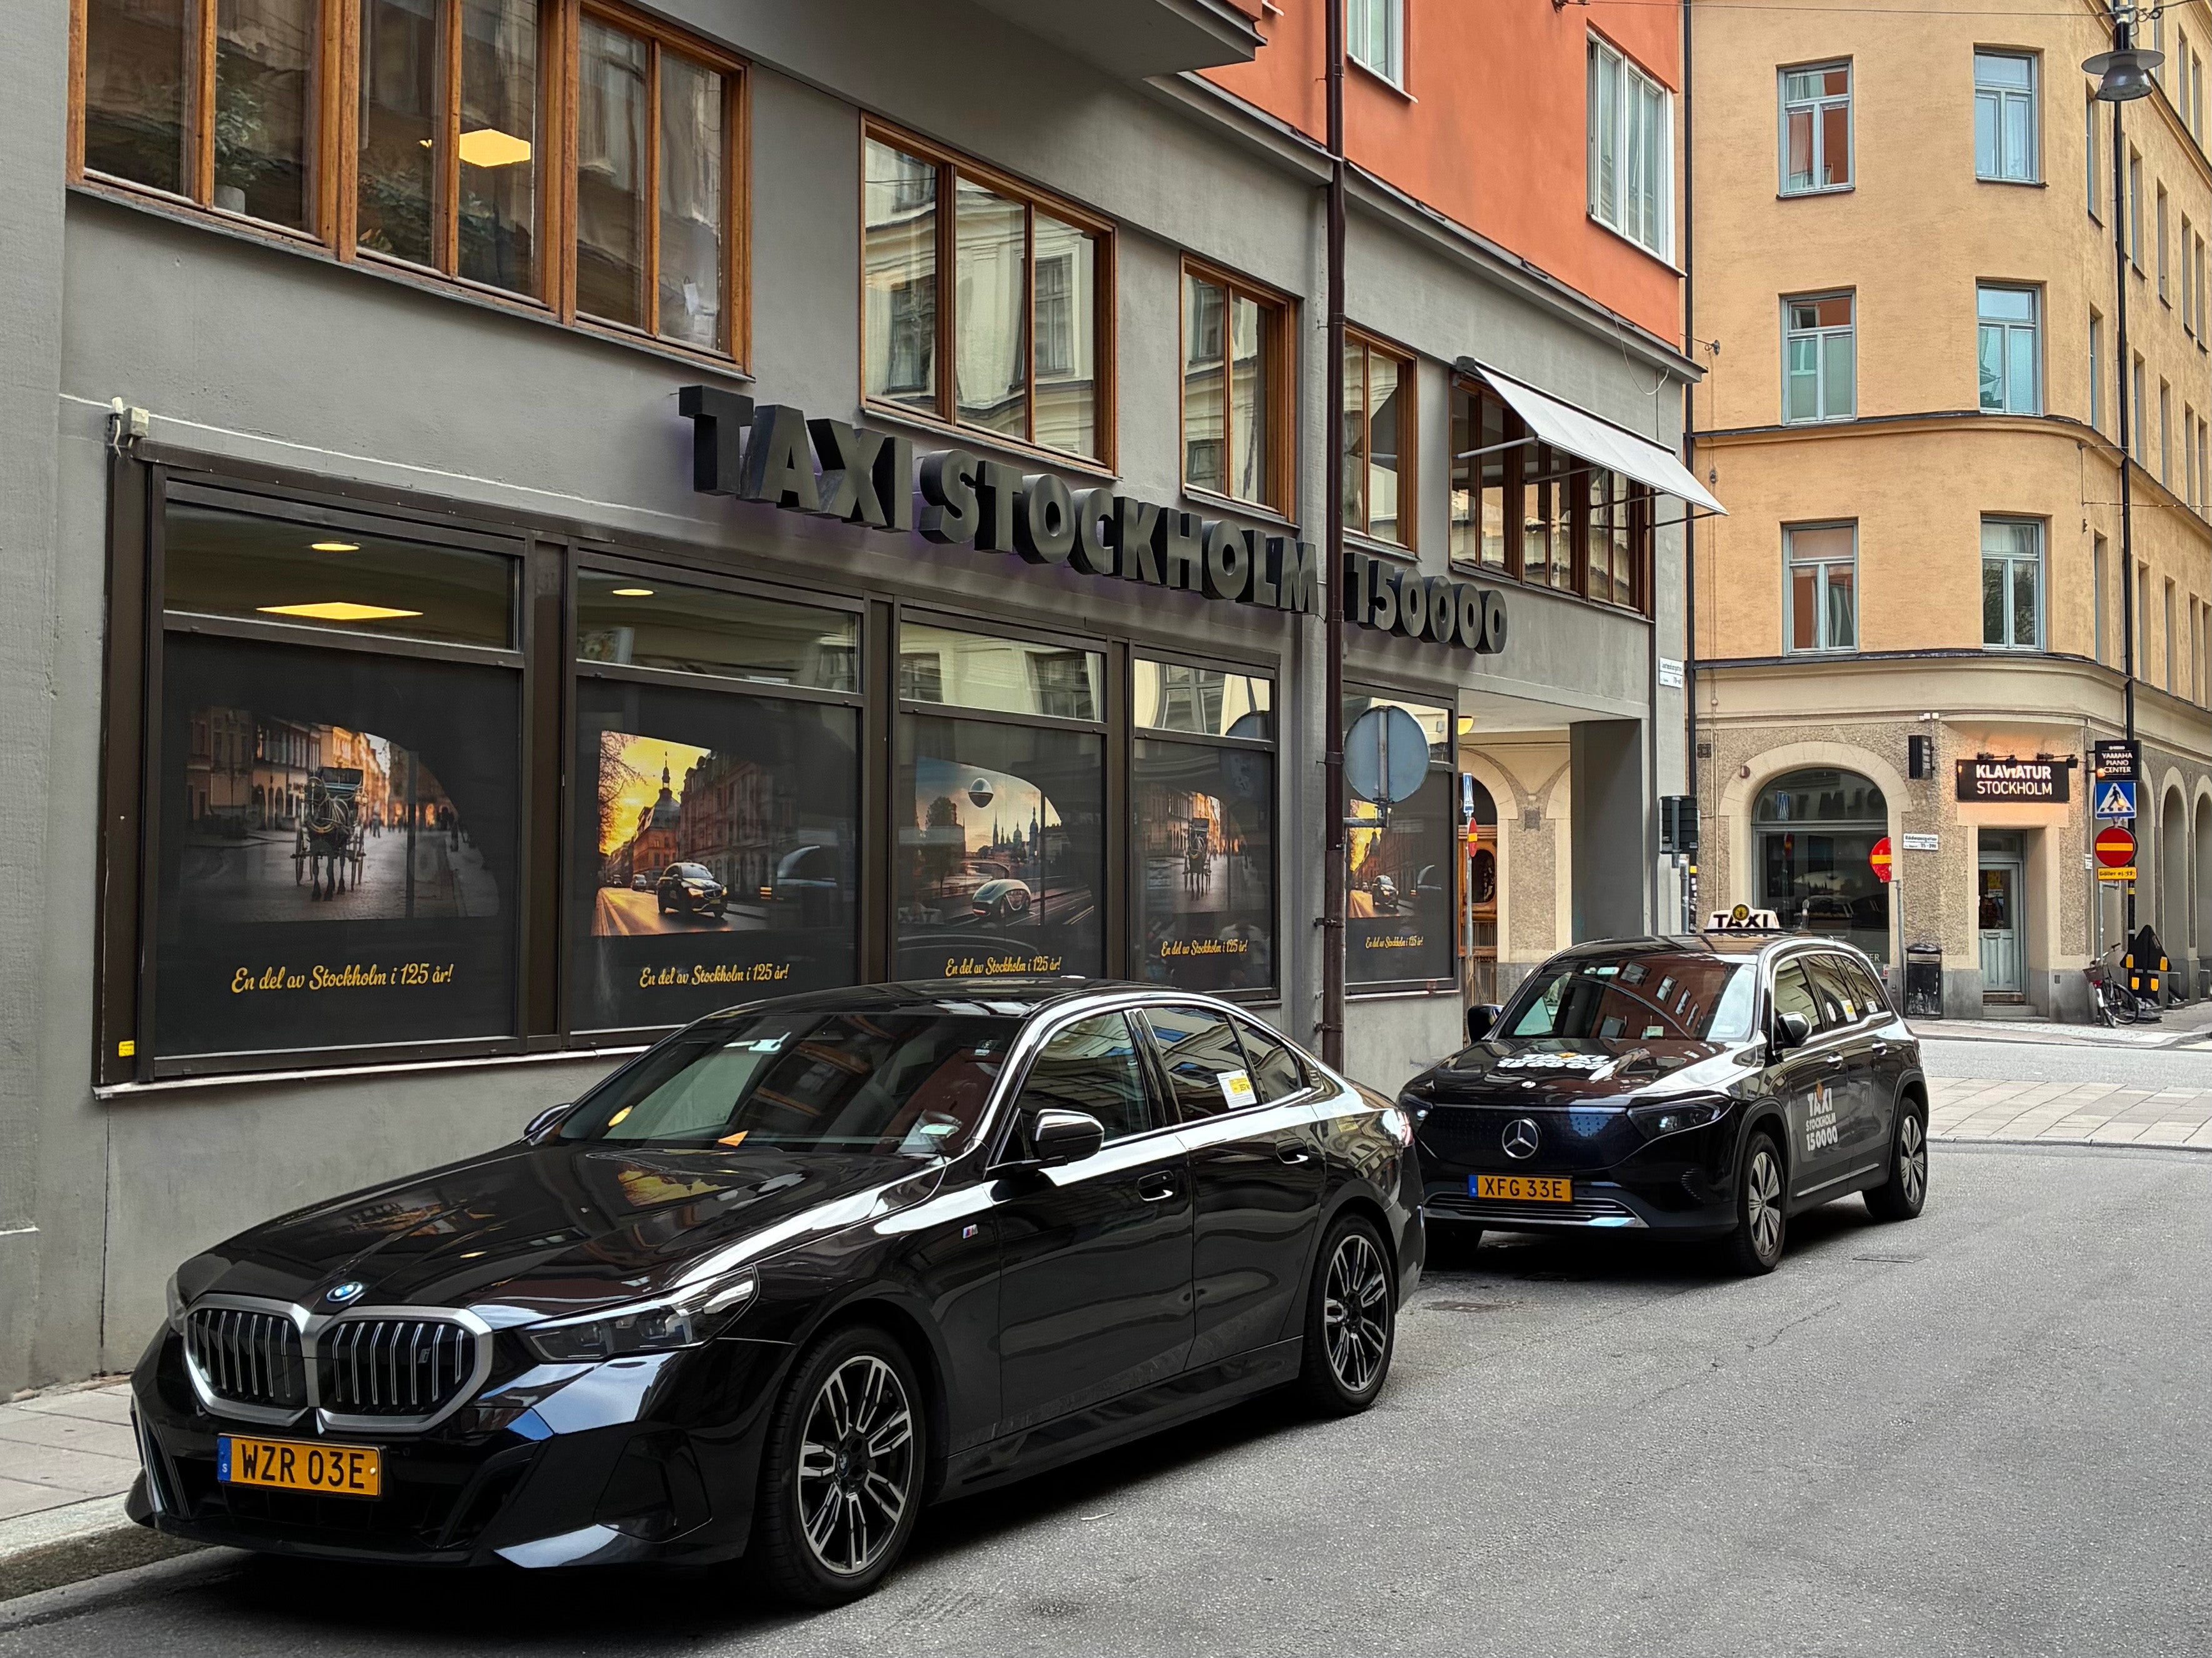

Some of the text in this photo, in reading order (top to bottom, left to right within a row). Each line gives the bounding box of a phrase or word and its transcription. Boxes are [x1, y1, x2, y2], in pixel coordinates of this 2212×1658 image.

[679, 385, 1508, 654] TAXI STOCKHOLM 150000
[1976, 765, 2051, 779] KLAVIATUR
[1977, 781, 2052, 795] STOCKHOLM
[1713, 914, 1768, 928] TAXI
[1161, 941, 1171, 957] En
[231, 963, 454, 993] En del av Stockholm i 125 år!
[639, 963, 789, 988] En del av Stockholm i 125 år!
[946, 956, 1062, 977] En del av Stockholm i 125 år!
[1808, 1088, 1833, 1117] TAXI
[1806, 1125, 1838, 1151] 150000
[1485, 1178, 1563, 1198] XFG 33E
[241, 1444, 365, 1489] WZR 03E
